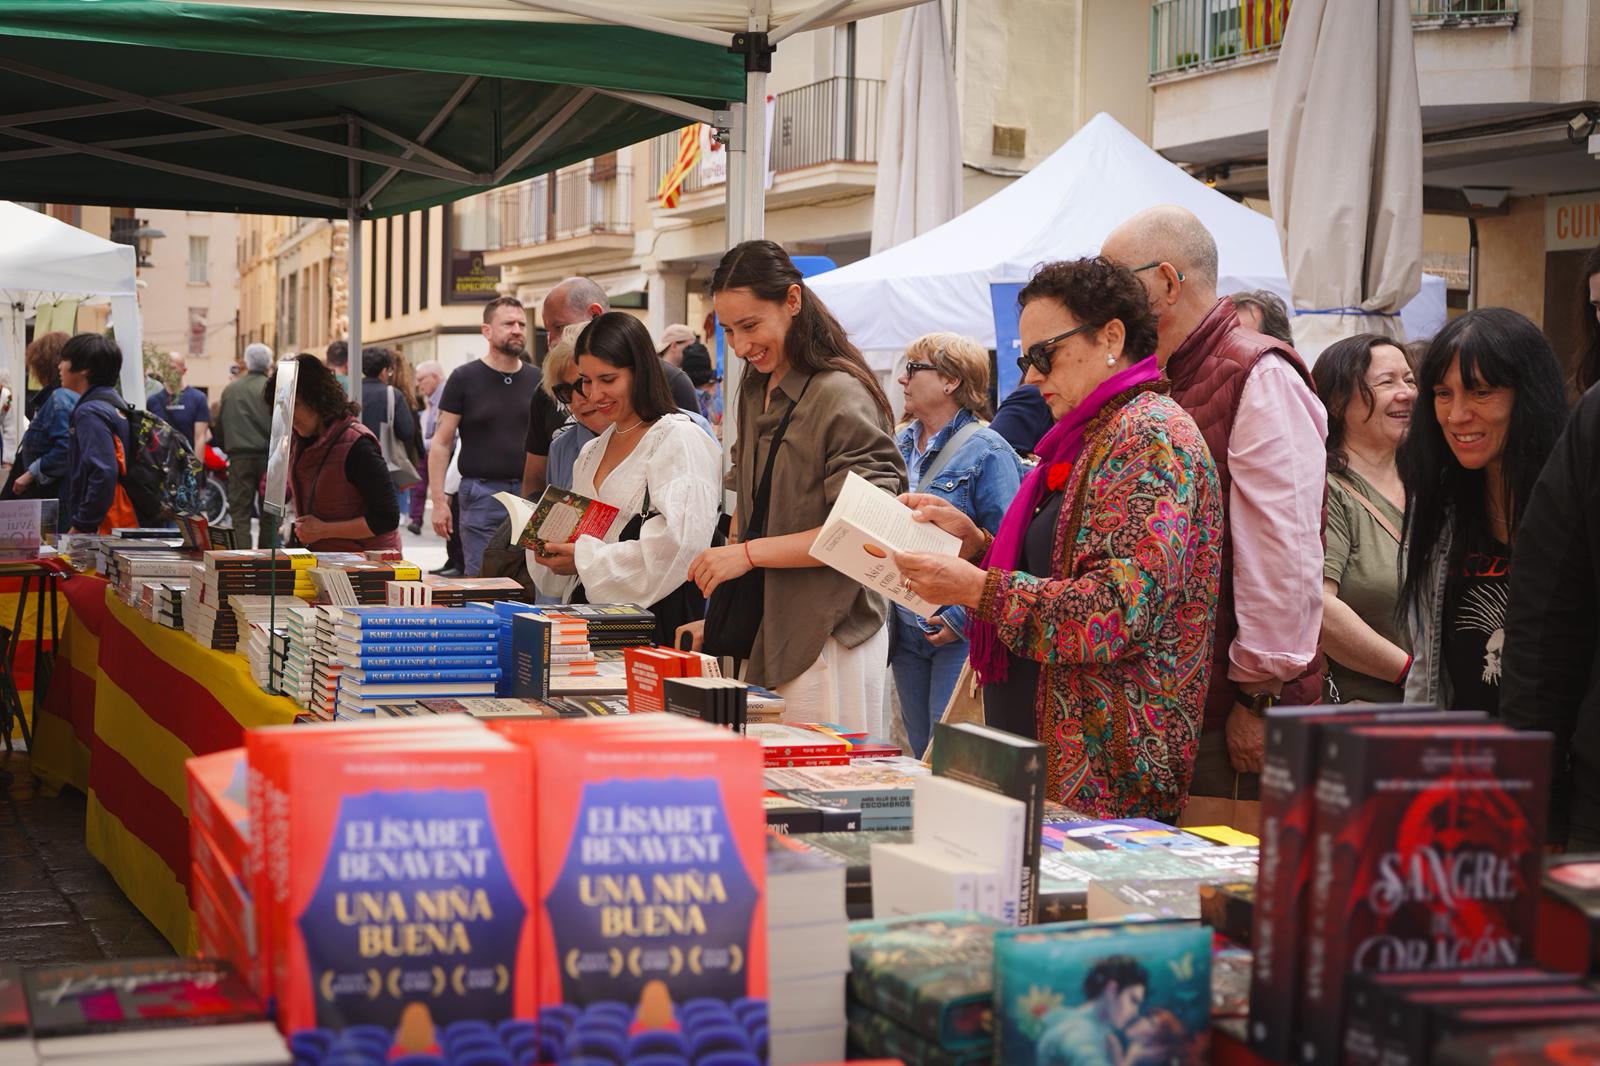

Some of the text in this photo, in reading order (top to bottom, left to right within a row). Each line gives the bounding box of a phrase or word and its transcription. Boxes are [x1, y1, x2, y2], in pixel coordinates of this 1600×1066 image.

[367, 617, 390, 625] ISABEL
[394, 617, 425, 625] ALLENDE
[369, 631, 393, 639] ISABEL
[396, 631, 429, 639] ALLENDE
[367, 645, 390, 653] ISABEL
[394, 645, 425, 653] ALLENDE
[588, 801, 718, 834] ELÍSABET
[860, 801, 911, 809] ESCOMBROS
[344, 816, 484, 850] ELÍSABET
[582, 834, 724, 865] BENAVENT
[338, 850, 491, 882] BENAVENT
[1370, 848, 1521, 914] SANGRE
[579, 868, 728, 906] UNA NIÑA
[335, 886, 494, 923] UNA NIÑA
[602, 905, 707, 938] BUENA
[359, 922, 472, 957] BUENA
